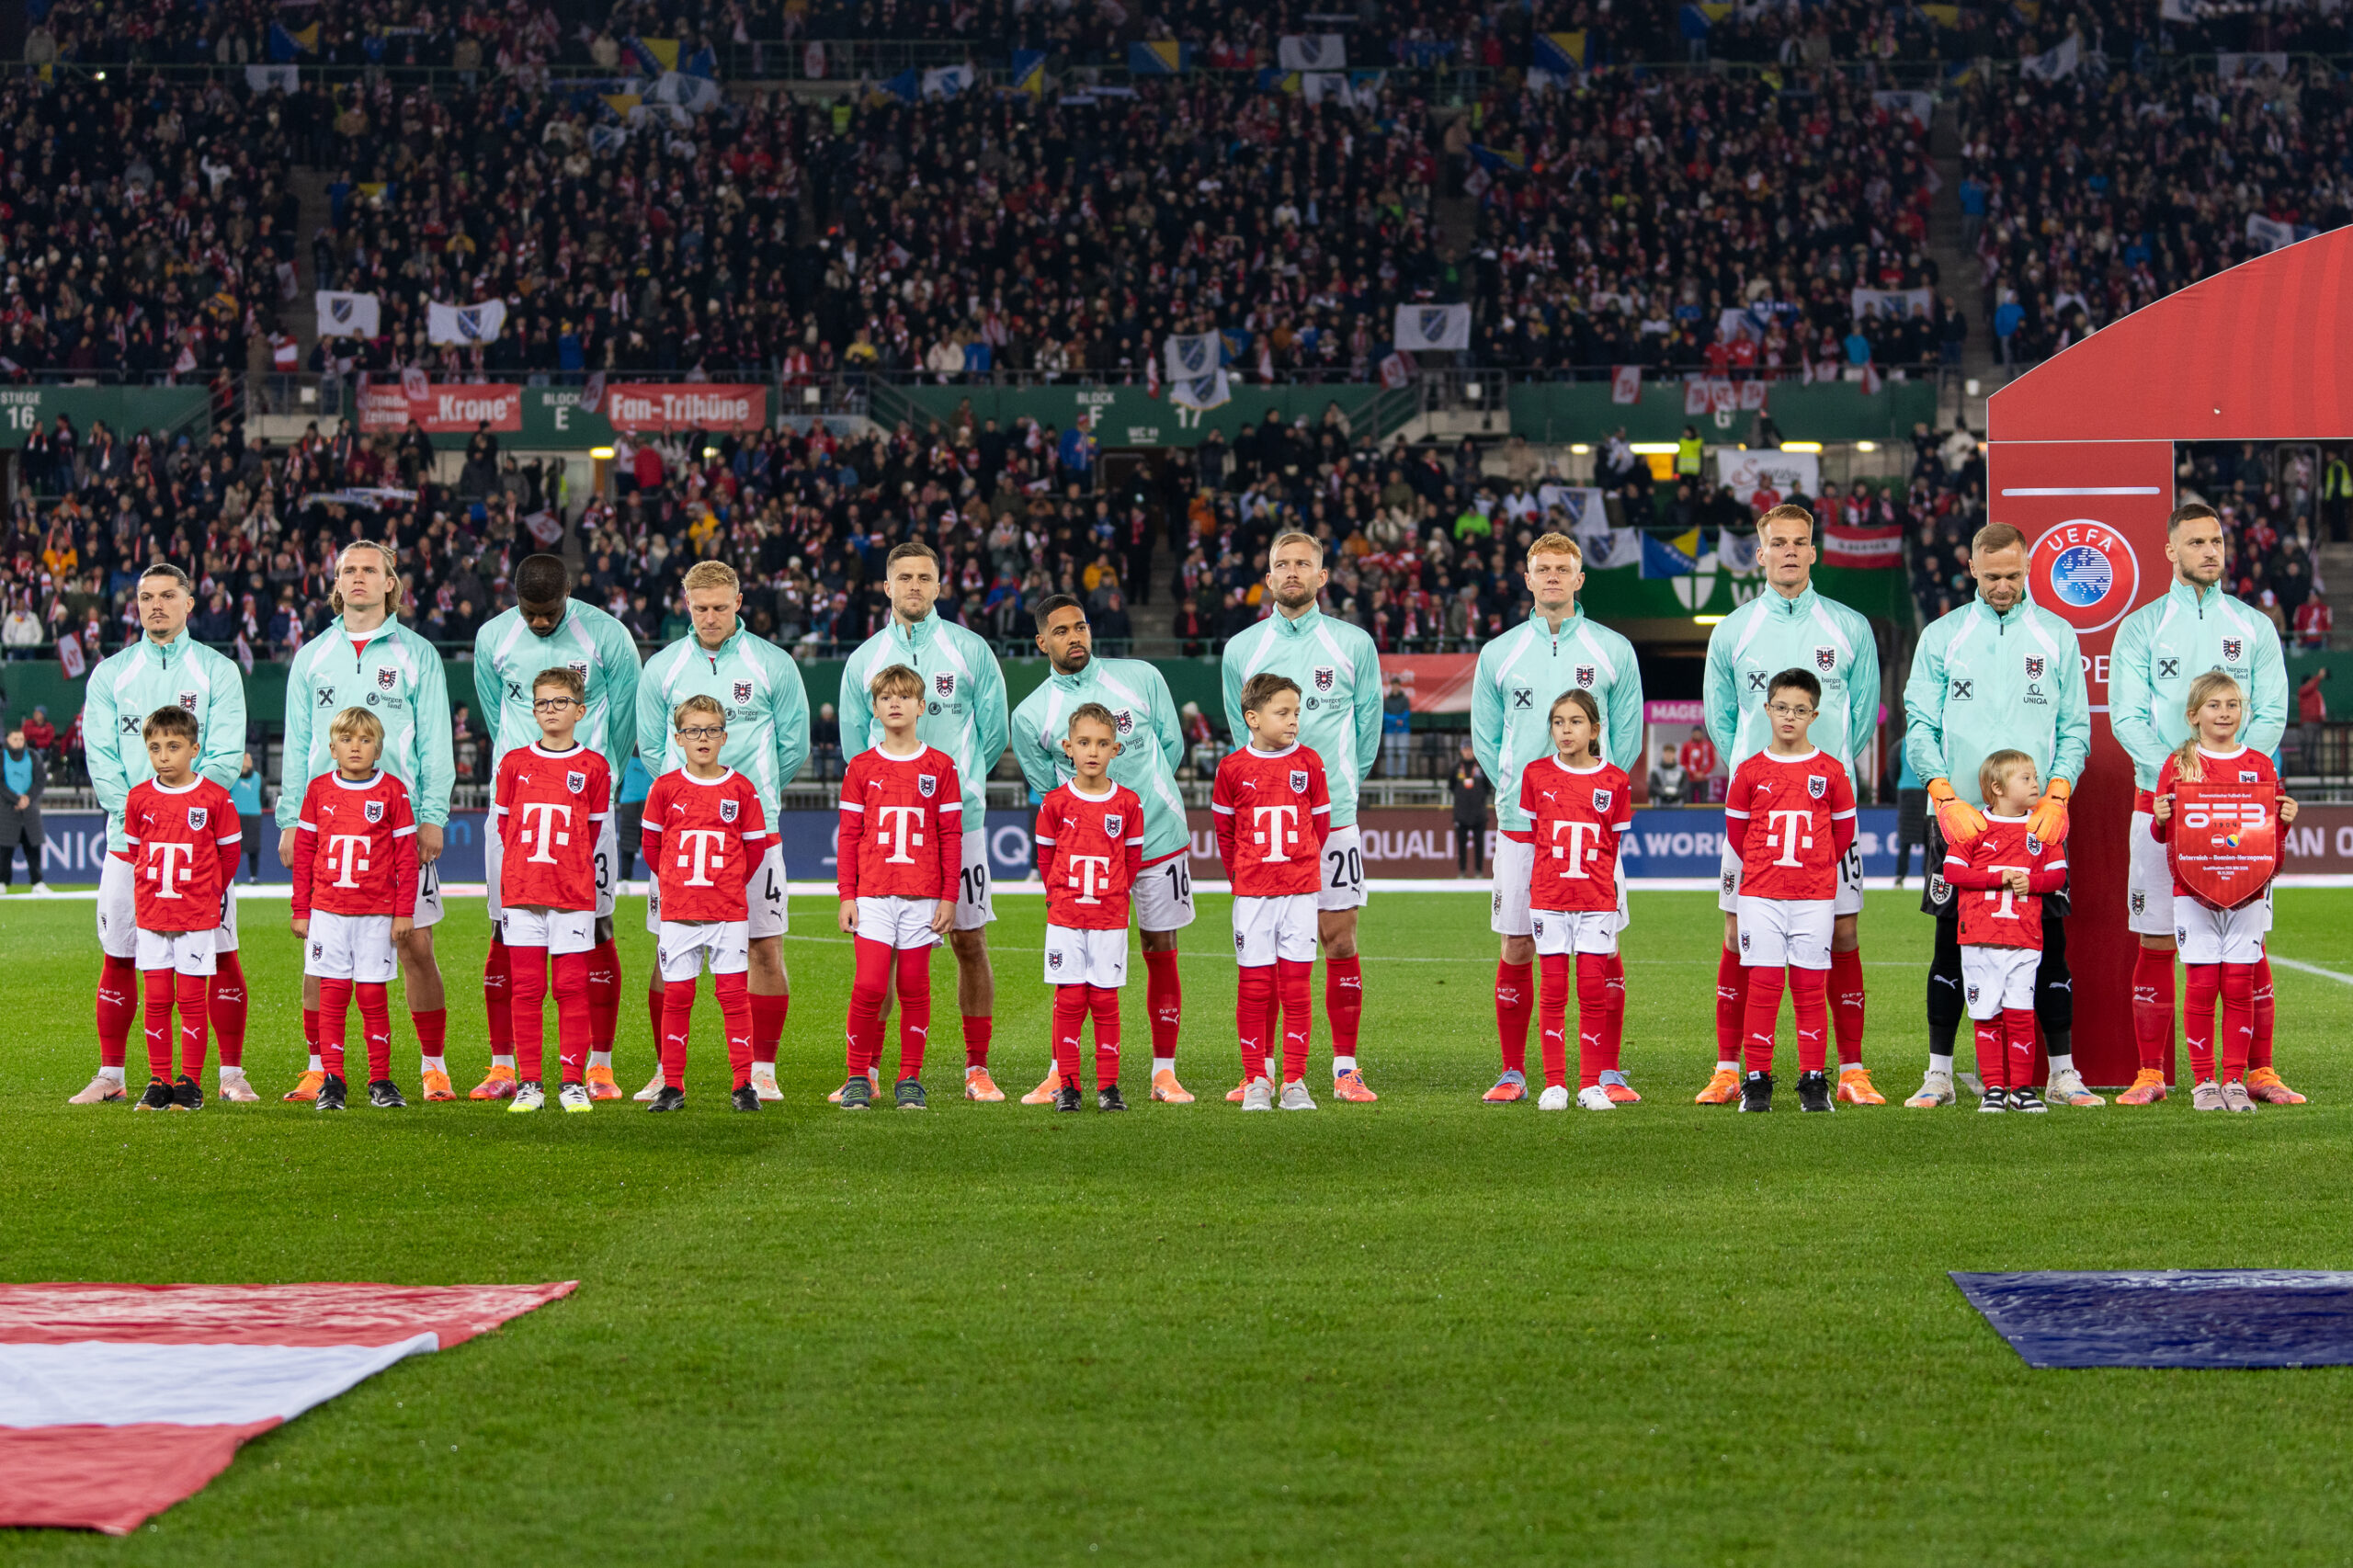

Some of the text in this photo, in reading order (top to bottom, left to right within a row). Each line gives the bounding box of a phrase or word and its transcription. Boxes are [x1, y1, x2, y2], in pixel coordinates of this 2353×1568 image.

[1, 392, 41, 404] STIEGE
[7, 405, 35, 429] 16
[542, 392, 581, 405] BLOCK
[555, 406, 569, 430] E
[611, 393, 749, 421] Fan-Tribüne
[1076, 392, 1115, 404] BLOCK
[1089, 405, 1103, 428] F
[2048, 528, 2113, 551] UEFA
[2023, 697, 2048, 705] UNIQA
[522, 803, 571, 864] T
[879, 806, 926, 863] T
[1254, 806, 1298, 862] T
[1552, 821, 1600, 878] T
[1768, 811, 1812, 867] T
[148, 842, 192, 899] T
[329, 835, 371, 888] T
[677, 830, 725, 886] T
[1328, 846, 1360, 888] 20
[765, 868, 781, 903] 4
[961, 864, 984, 904] 19
[1069, 855, 1108, 904] T
[1165, 859, 1188, 900] 16
